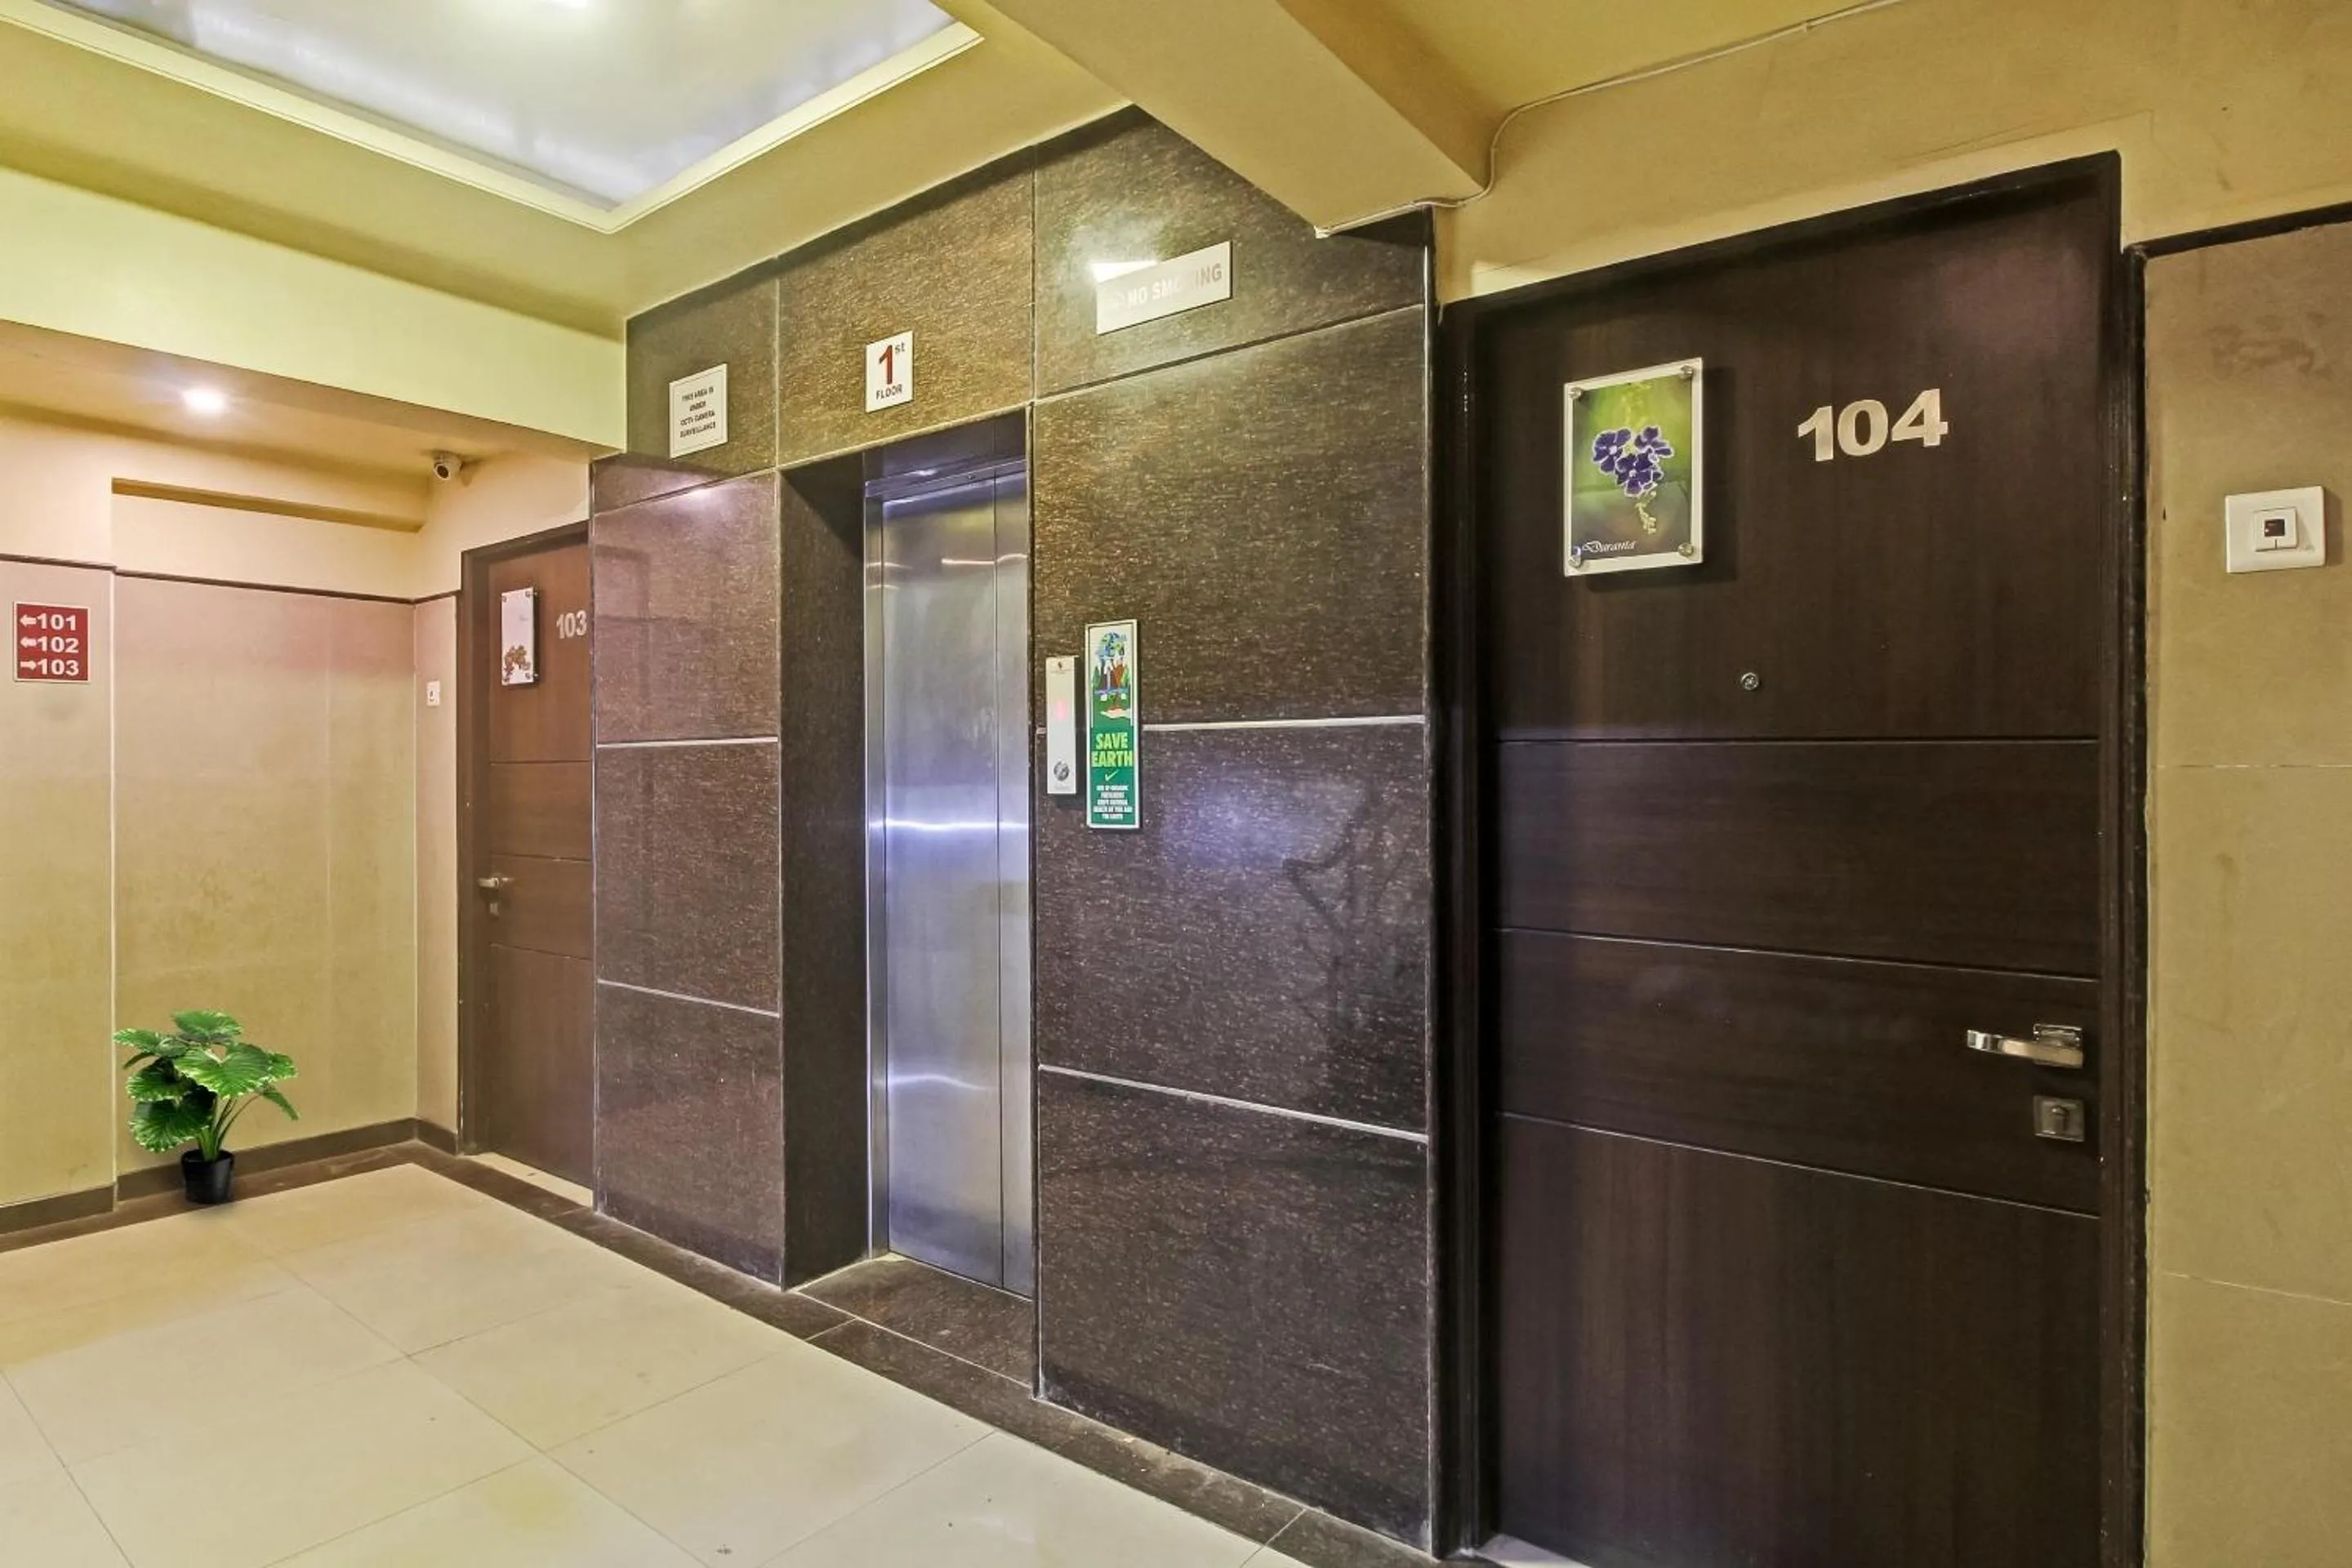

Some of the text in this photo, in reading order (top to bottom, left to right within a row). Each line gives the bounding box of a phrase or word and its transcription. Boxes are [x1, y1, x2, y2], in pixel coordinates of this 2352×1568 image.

[1127, 262, 1223, 308] NO SMOING
[876, 384, 902, 399] FLOOR
[1797, 388, 1949, 461] 104
[37, 612, 77, 631] 101
[555, 609, 587, 639] 103
[37, 635, 79, 653] 102
[37, 658, 79, 676] 103
[1095, 732, 1129, 750] SAVE
[1091, 751, 1133, 768] EARTH
